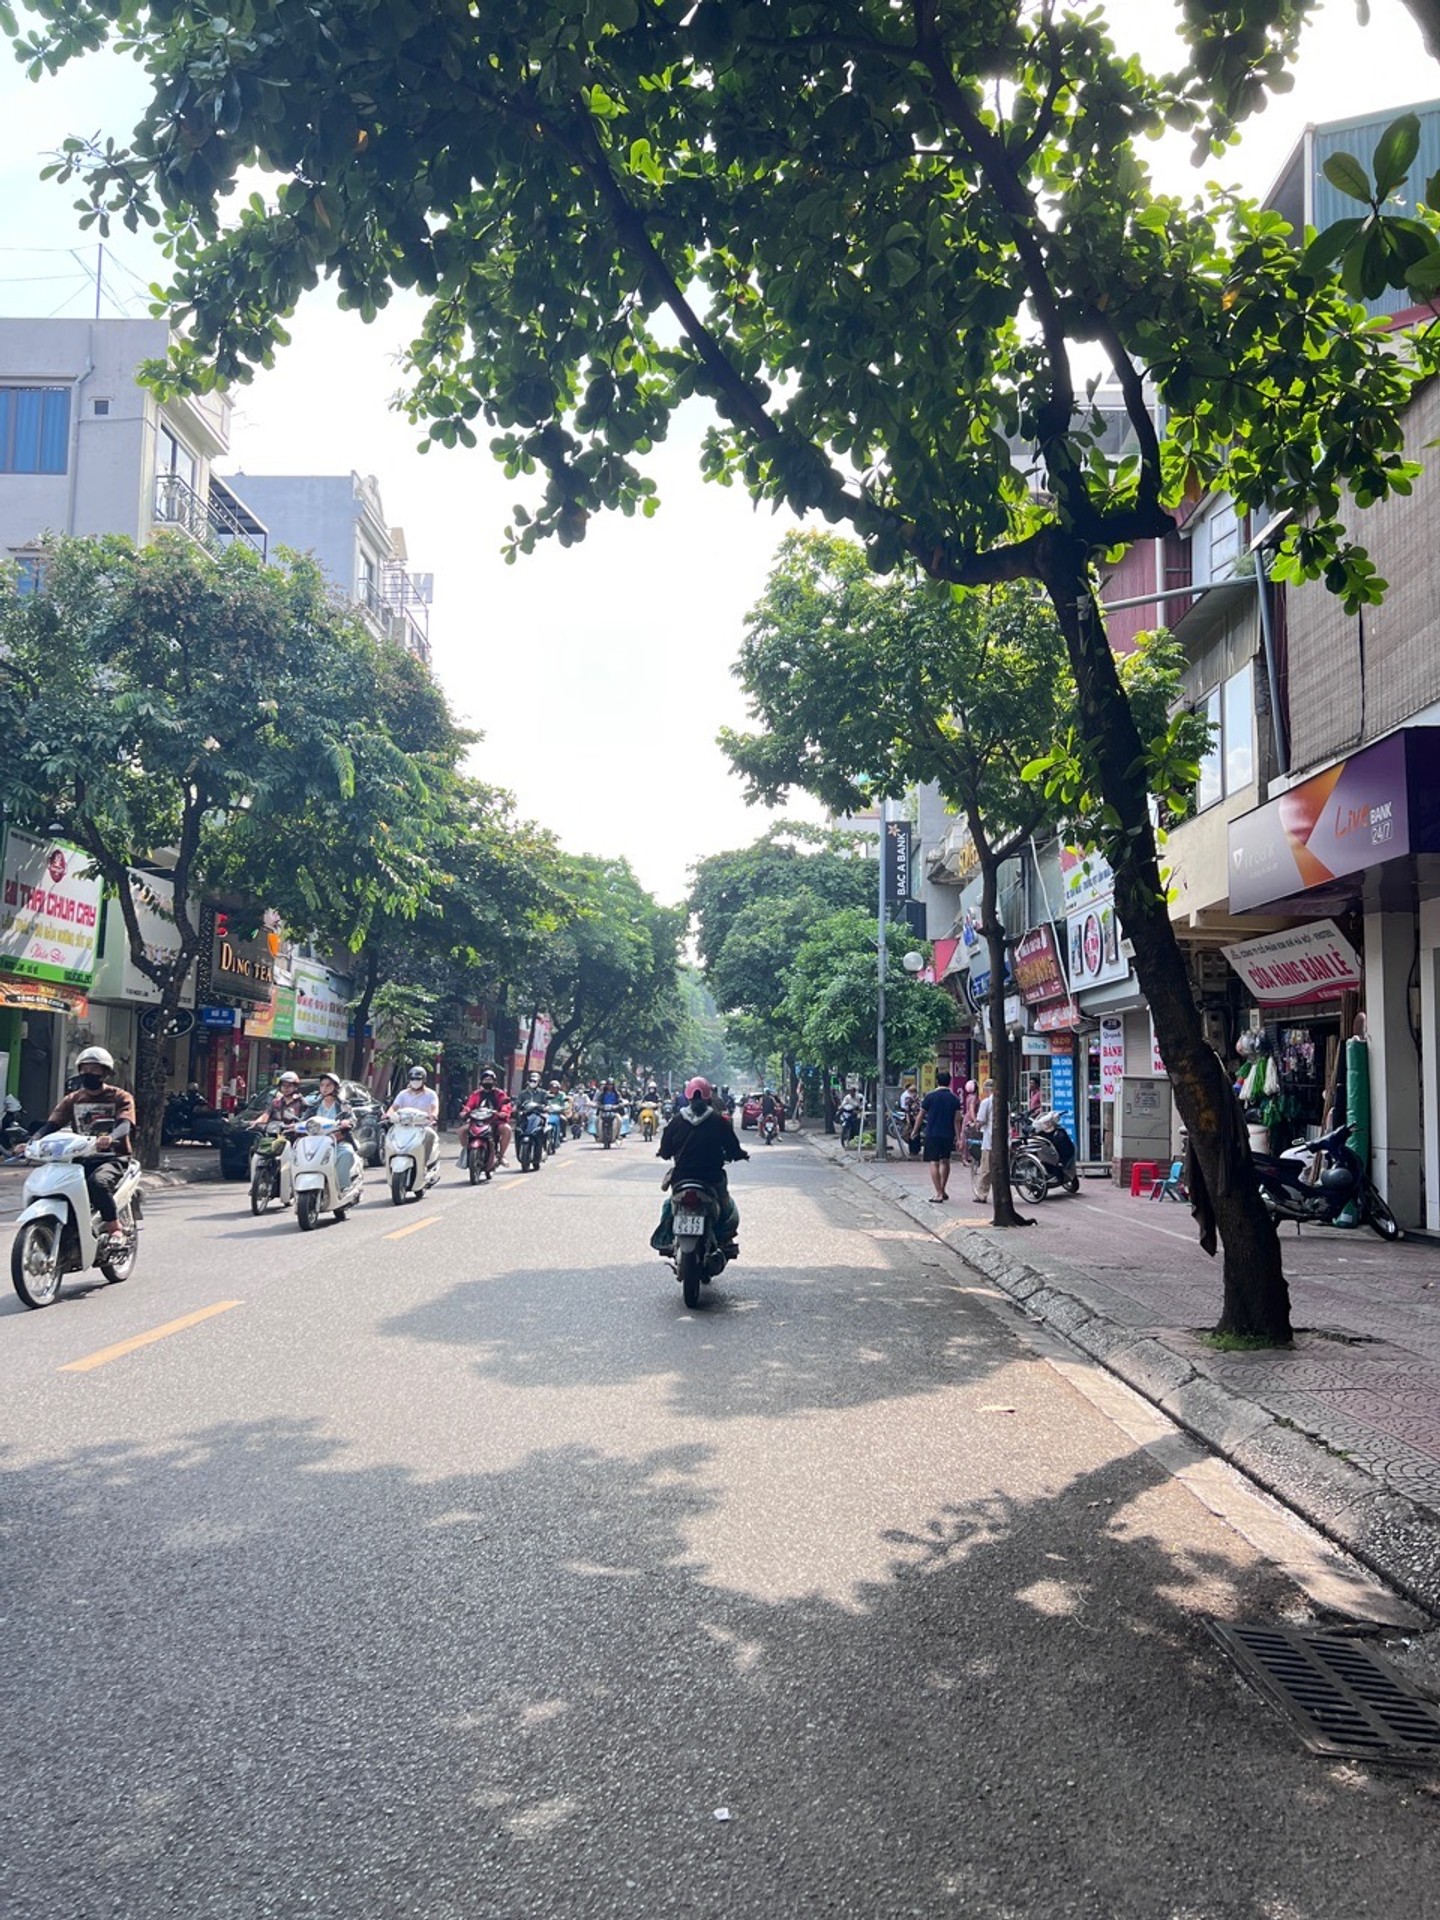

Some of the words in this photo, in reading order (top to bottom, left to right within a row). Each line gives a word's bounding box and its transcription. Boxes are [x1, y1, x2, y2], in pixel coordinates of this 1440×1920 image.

[1335, 804, 1369, 839] Live
[1370, 801, 1392, 825] BANK
[1372, 821, 1391, 843] 24/7
[896, 832, 906, 862] BANK
[896, 863, 906, 873] A
[896, 874, 906, 896] BAC
[221, 942, 251, 977] DING
[254, 963, 272, 982] TEA
[1248, 961, 1278, 990] CỬA
[1268, 960, 1309, 987] HÀNG
[1299, 952, 1336, 981] BÁN
[1326, 943, 1355, 977] LẺ
[1103, 1042, 1123, 1057] BÁNH
